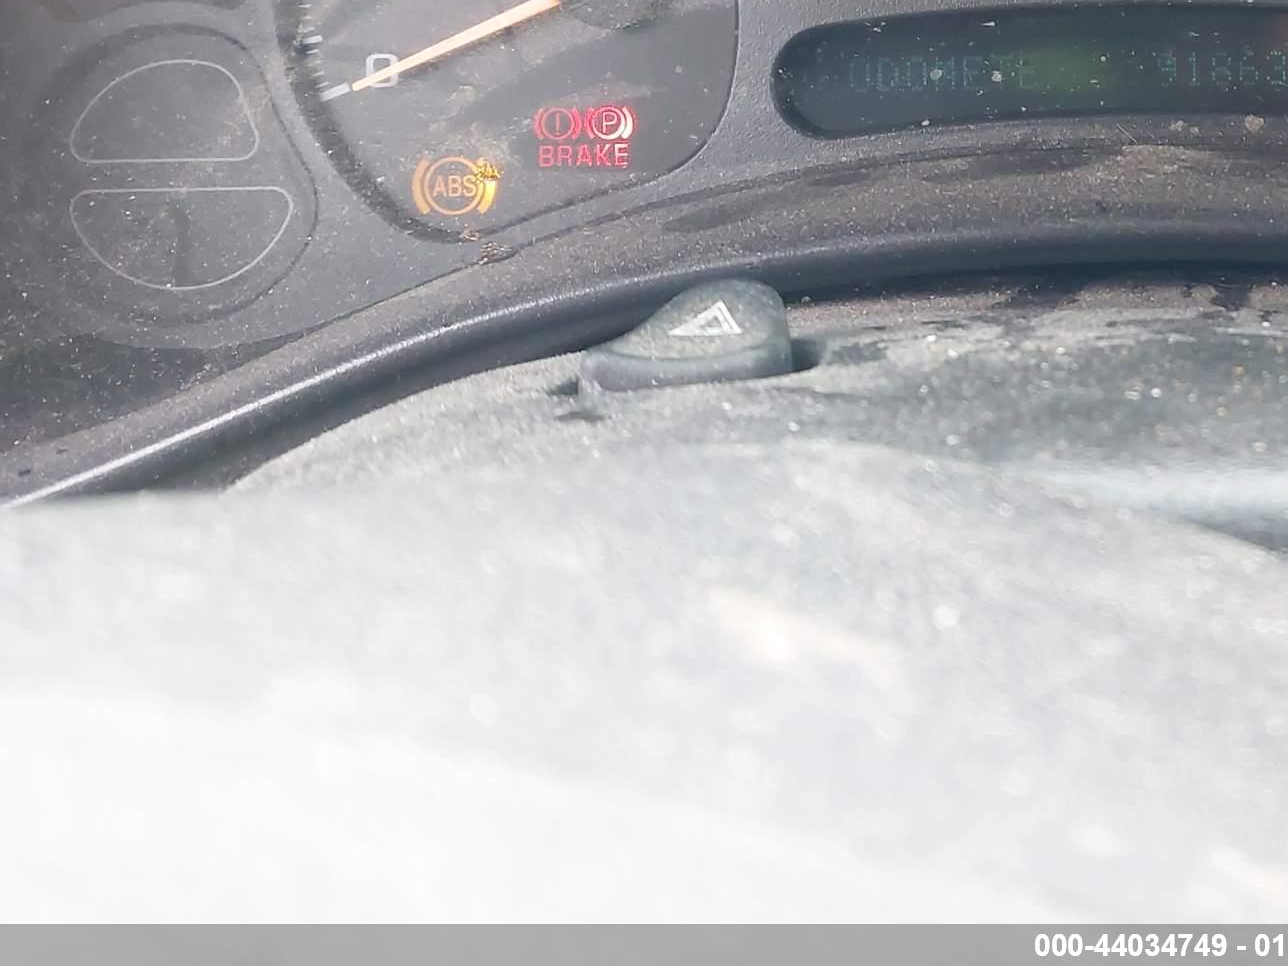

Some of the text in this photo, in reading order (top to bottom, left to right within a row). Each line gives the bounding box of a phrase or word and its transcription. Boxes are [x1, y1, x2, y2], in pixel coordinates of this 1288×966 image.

[365, 53, 399, 88] 0
[538, 142, 630, 168] BRAKE
[432, 174, 478, 198] ABS
